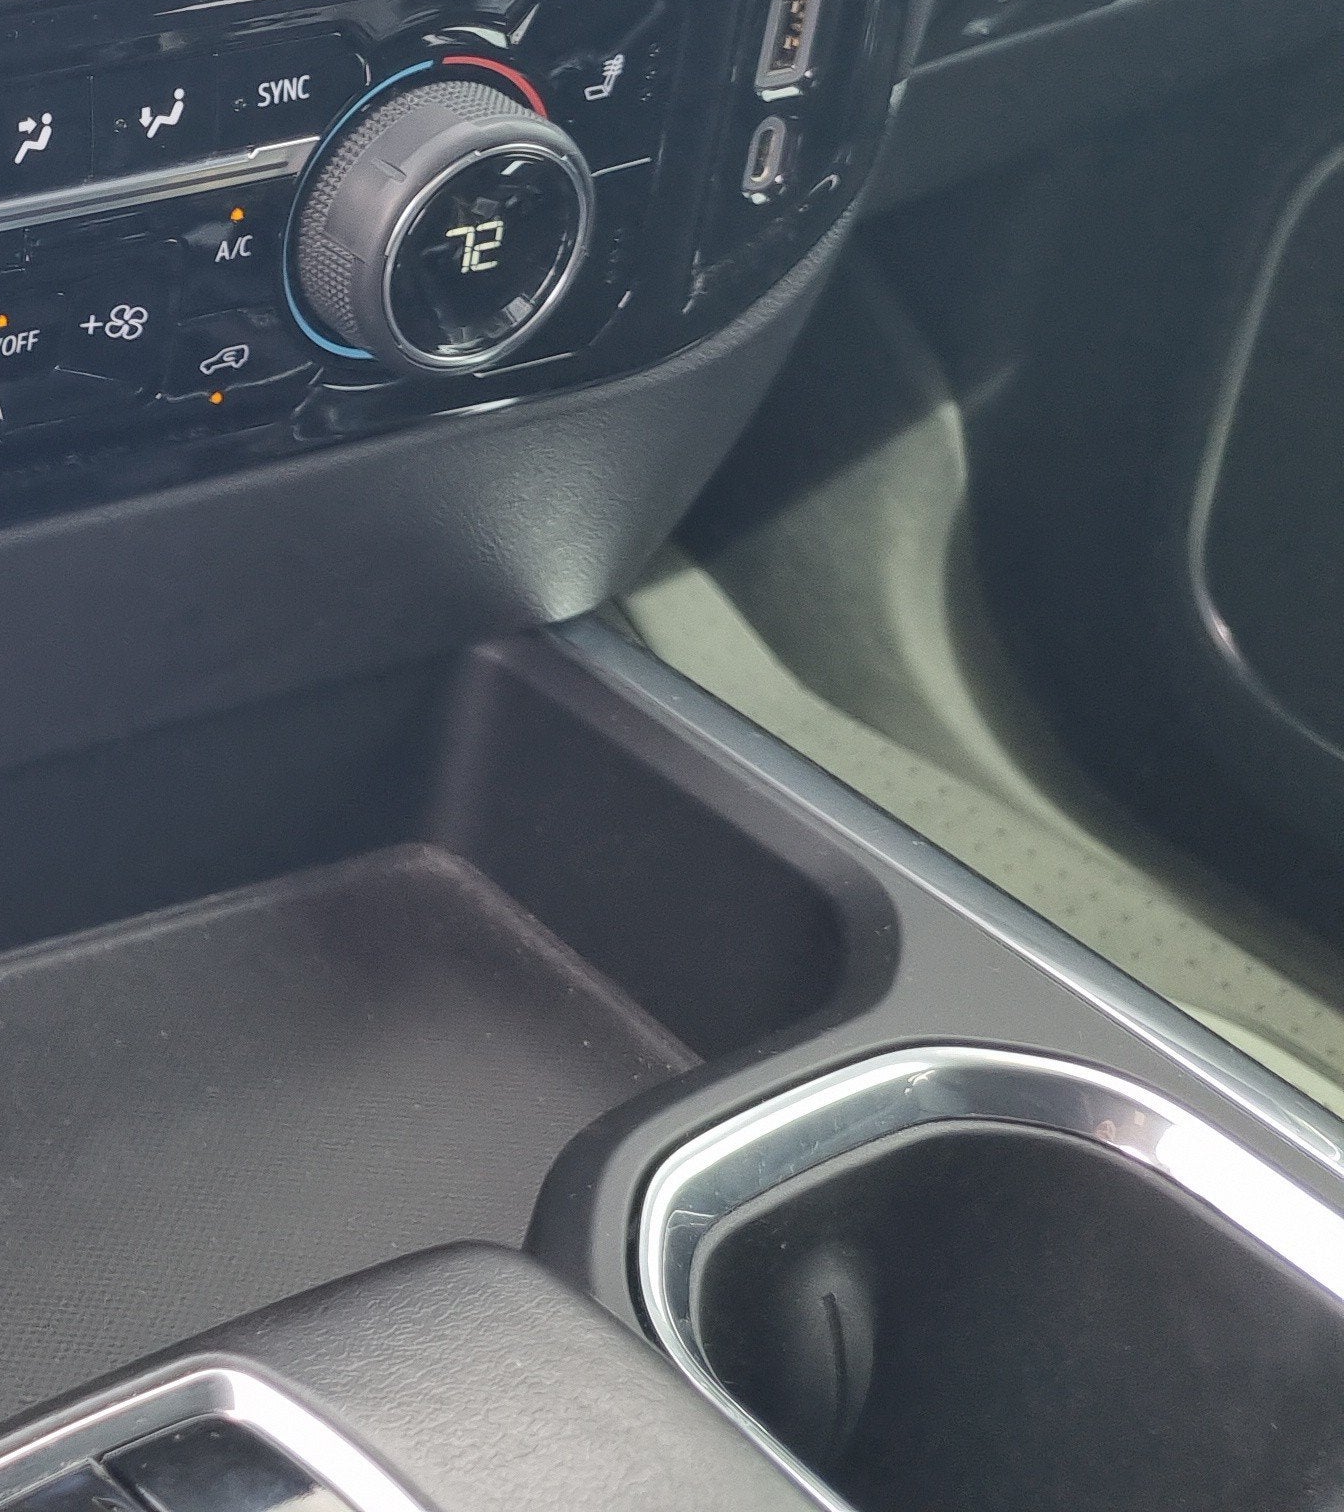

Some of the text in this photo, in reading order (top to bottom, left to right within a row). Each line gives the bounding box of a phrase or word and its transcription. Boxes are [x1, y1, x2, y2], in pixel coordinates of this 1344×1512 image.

[257, 74, 310, 107] SYNC
[214, 234, 254, 263] A/C
[445, 220, 504, 274] 72
